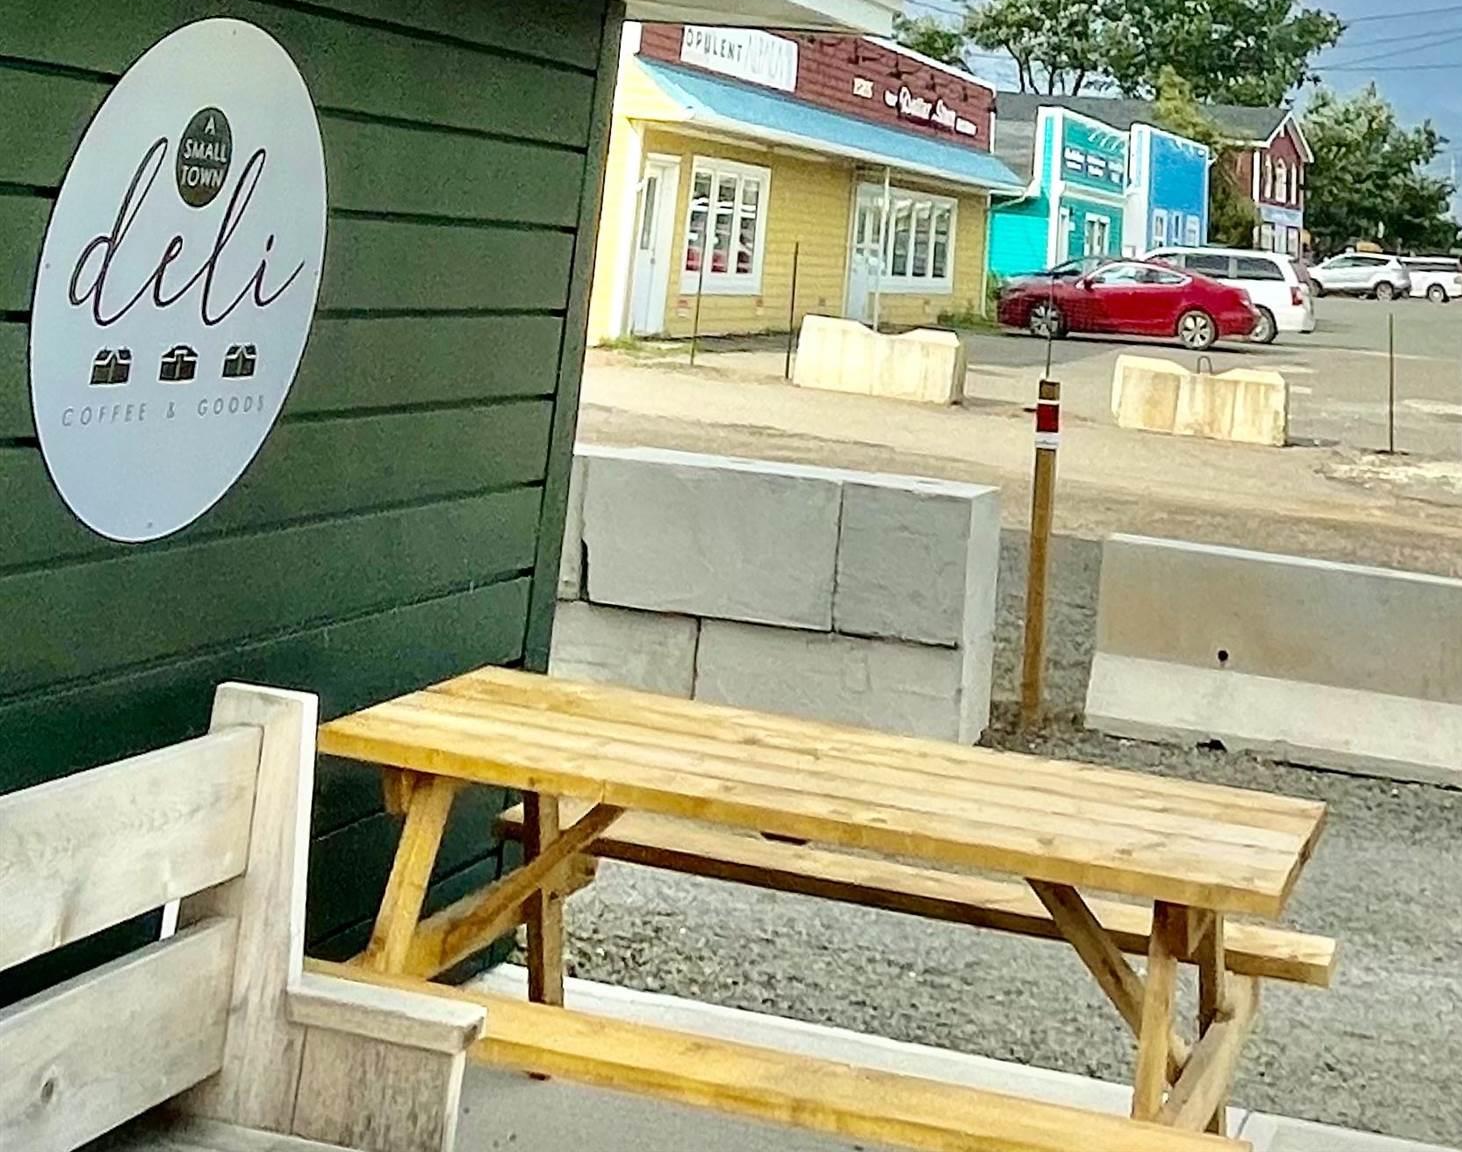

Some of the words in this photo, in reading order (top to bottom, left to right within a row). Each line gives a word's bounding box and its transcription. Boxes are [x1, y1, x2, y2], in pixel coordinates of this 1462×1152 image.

[686, 28, 743, 63] OPULENT
[204, 115, 216, 136] A
[183, 138, 228, 164] SMALL
[180, 164, 225, 188] TOWN
[68, 136, 305, 327] deli
[62, 401, 147, 427] COFFEE
[165, 400, 176, 419] &
[197, 393, 265, 417] GOODS
